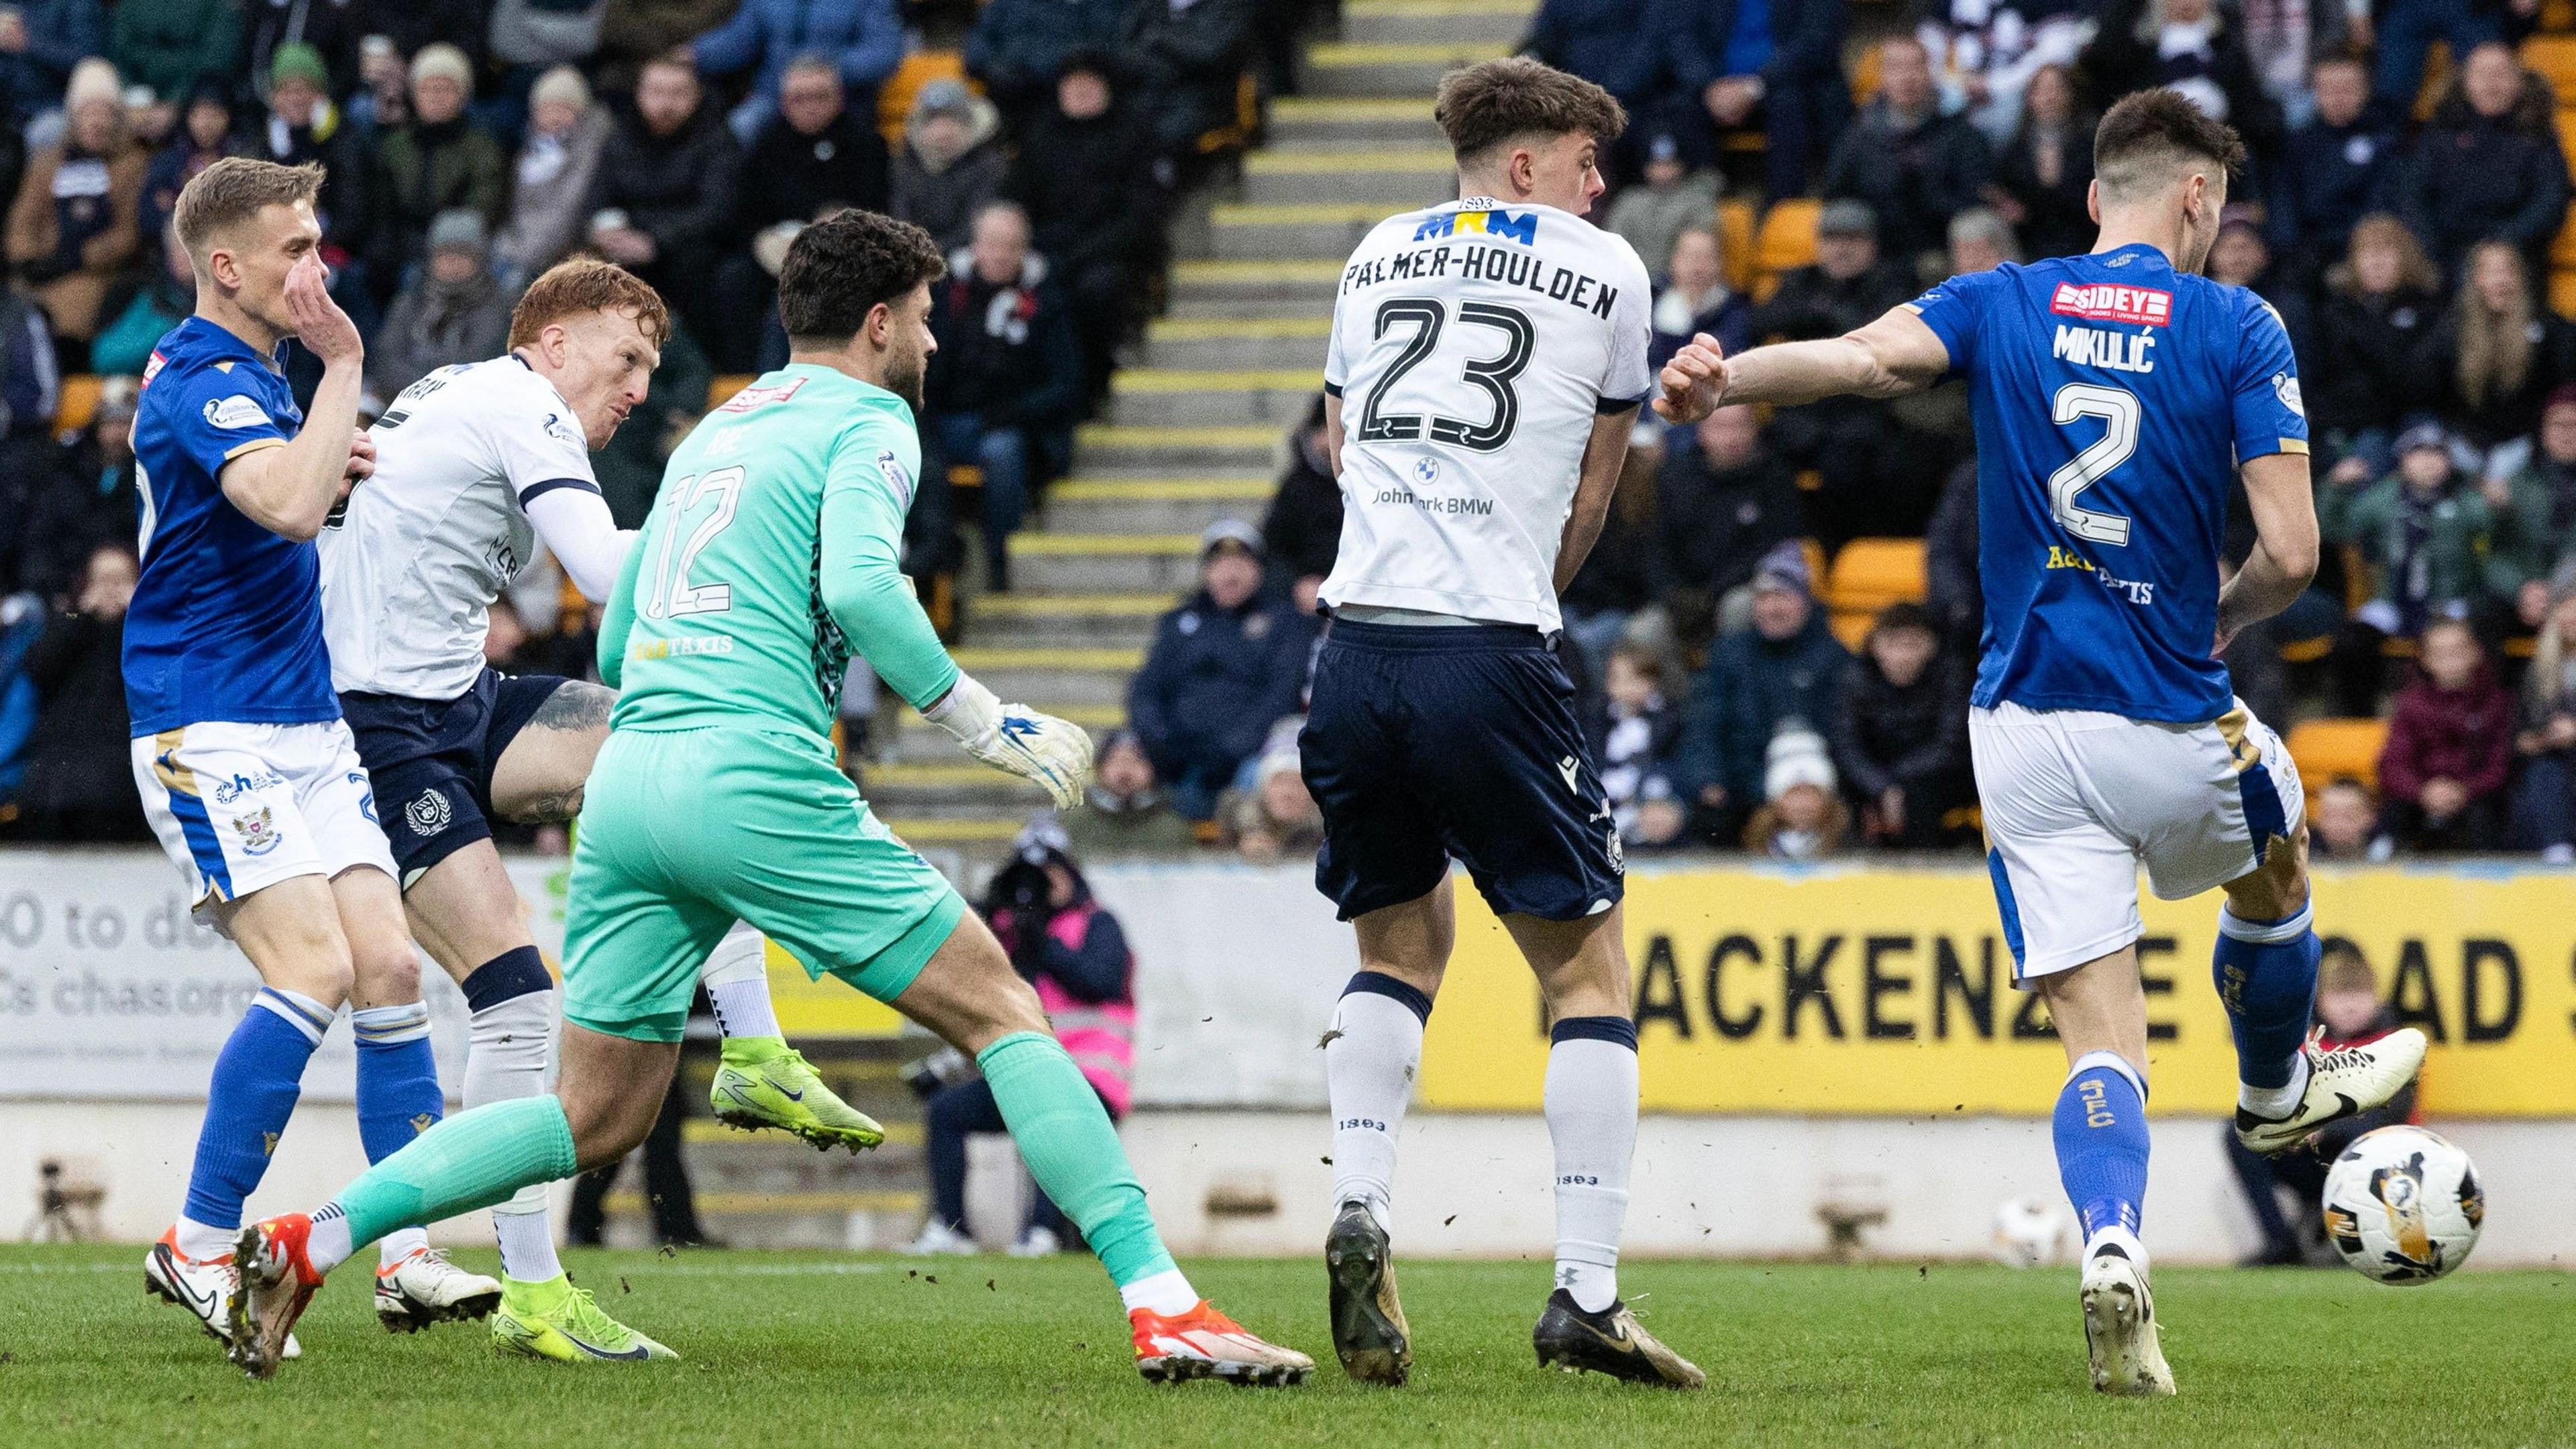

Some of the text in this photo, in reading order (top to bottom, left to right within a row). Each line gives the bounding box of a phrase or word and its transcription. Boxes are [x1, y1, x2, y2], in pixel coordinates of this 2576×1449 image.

[1458, 197, 1493, 209] 1893
[1343, 246, 1618, 321] PALMER-HOULDEN
[2074, 286, 2149, 313] SIDEY
[1358, 296, 1538, 455] 23
[2053, 324, 2156, 374] MIKULIĆ
[2047, 382, 2141, 547] 2
[1447, 498, 1494, 515] BMW
[646, 464, 746, 619] 12
